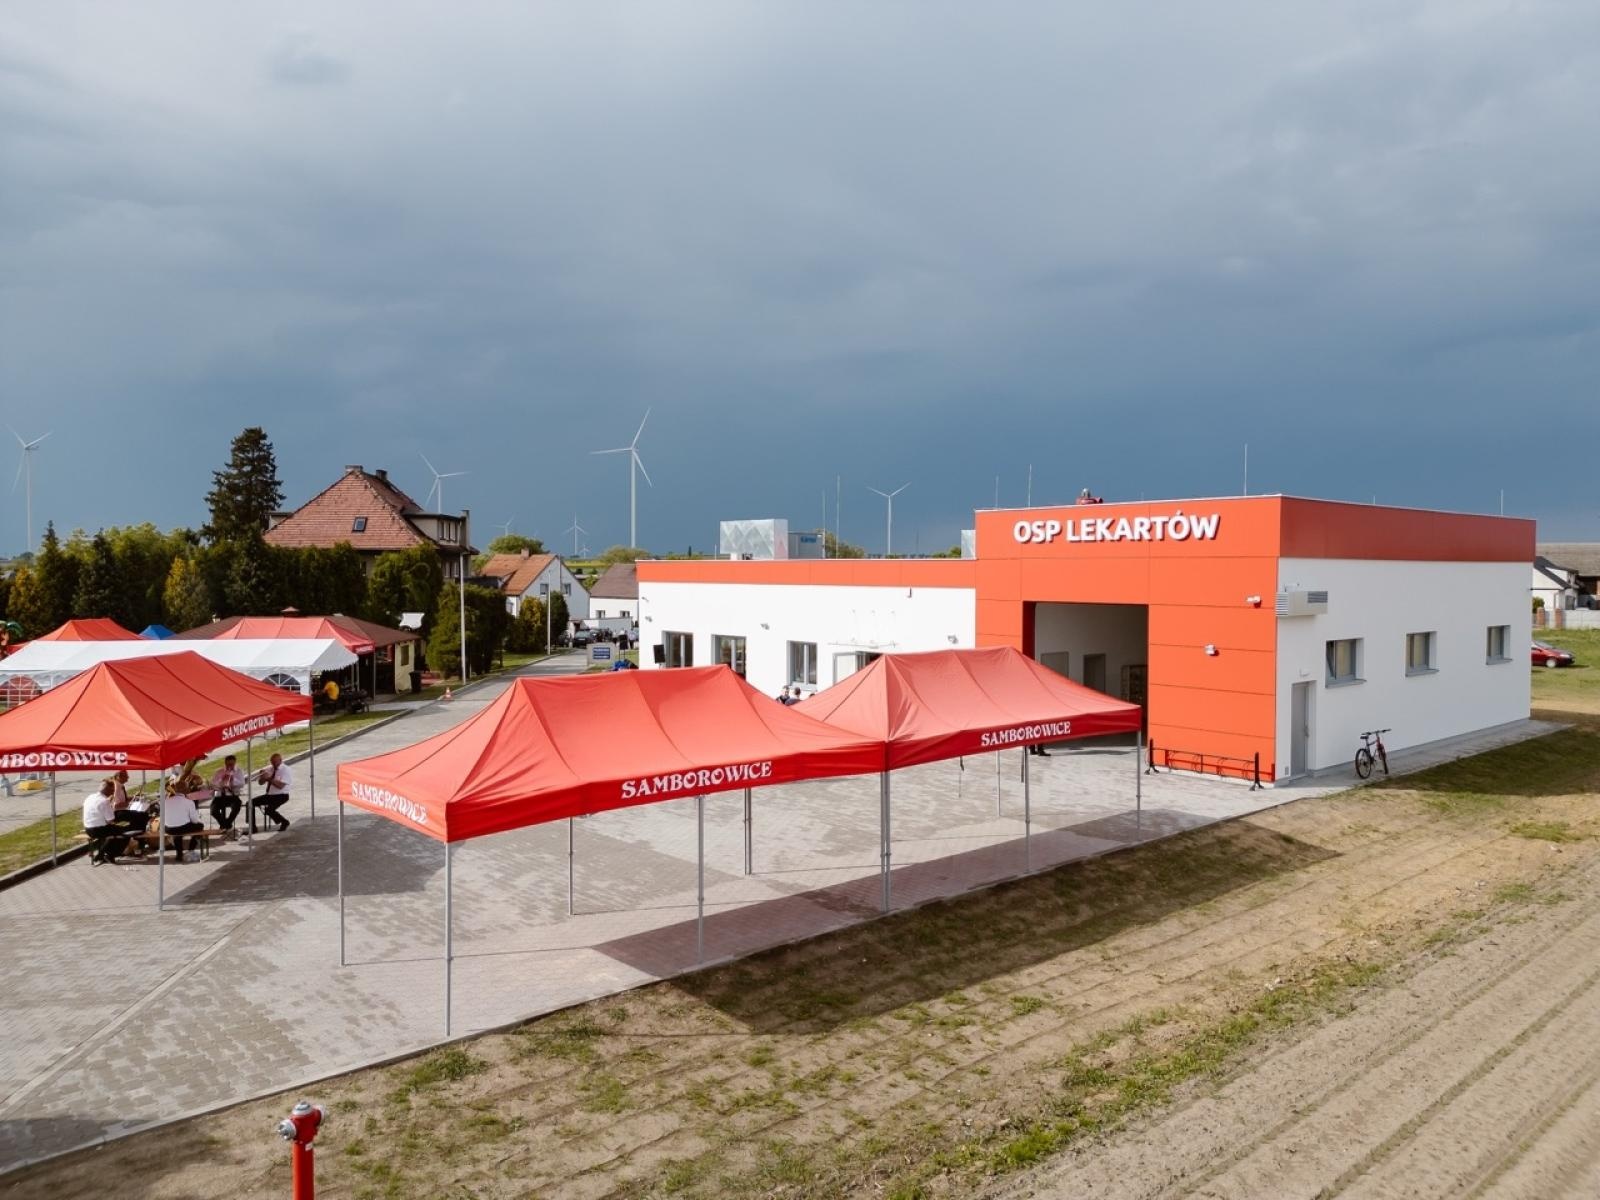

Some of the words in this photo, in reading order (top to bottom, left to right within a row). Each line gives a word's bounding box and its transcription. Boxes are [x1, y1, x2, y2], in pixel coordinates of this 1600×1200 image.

[1013, 519, 1062, 544] OSP
[1066, 509, 1221, 542] LEKARTÓW
[981, 721, 1071, 746] SAMBOROWICE
[621, 761, 773, 799] SAMBOROWICE
